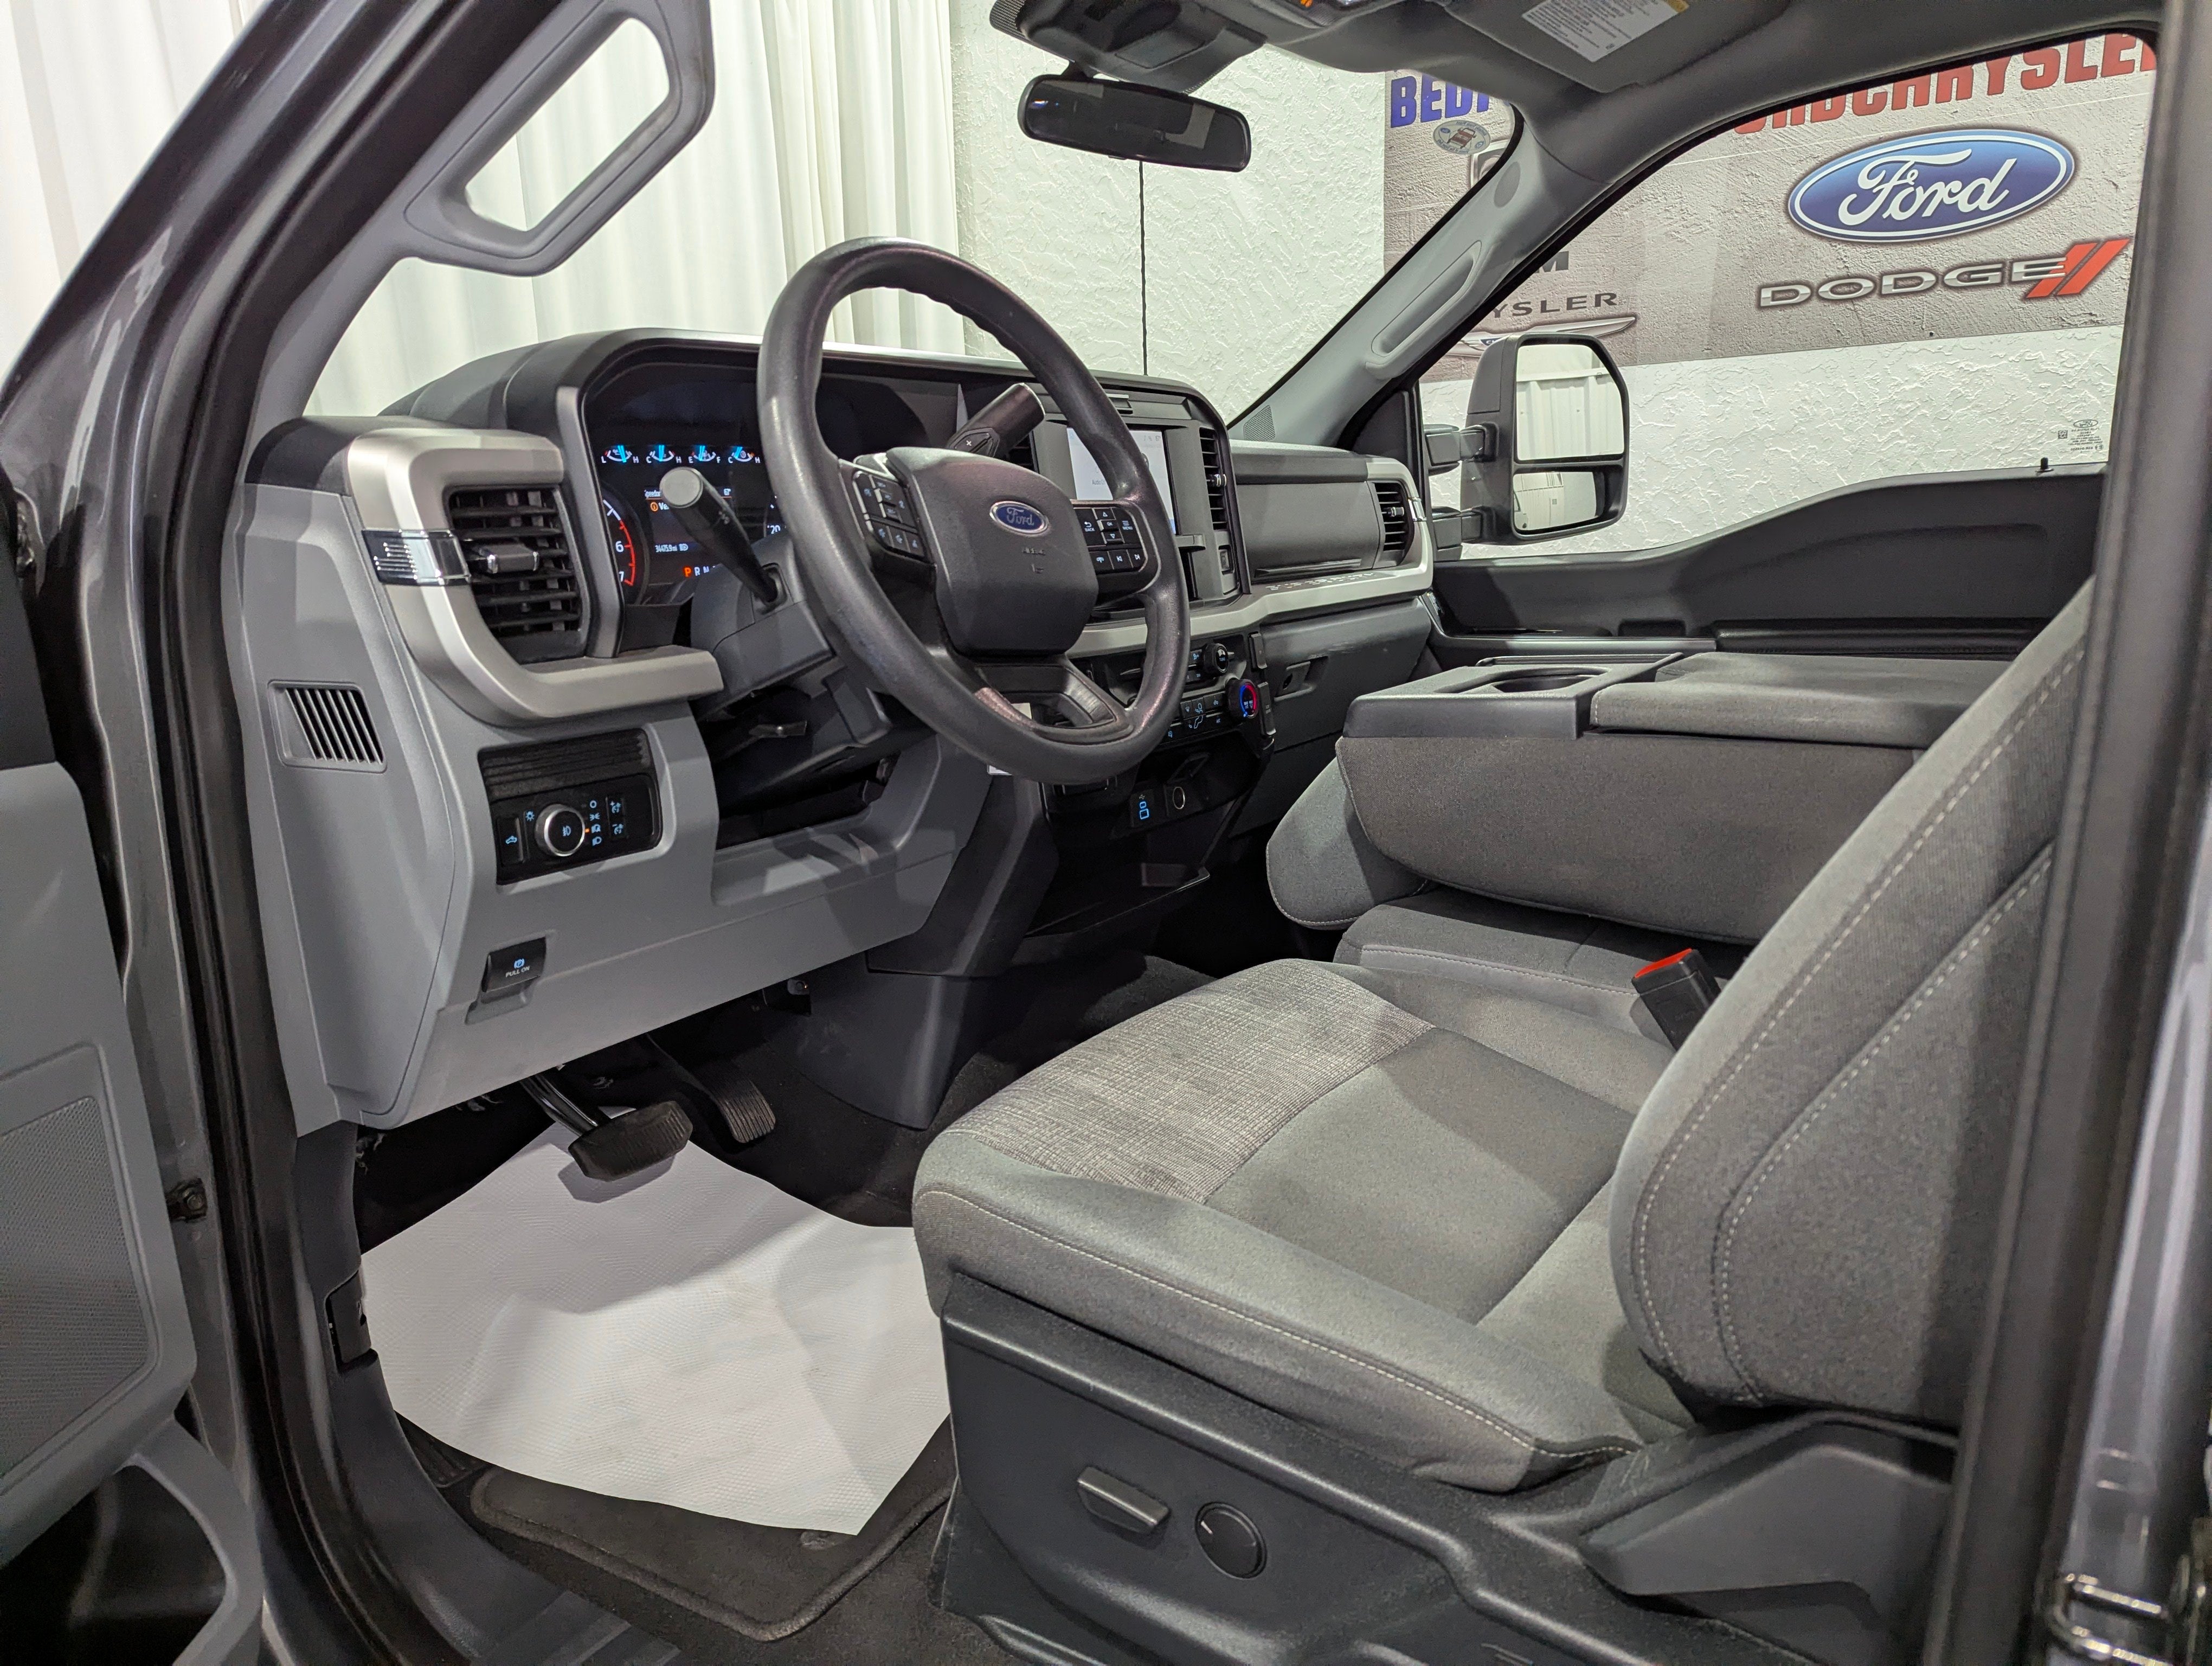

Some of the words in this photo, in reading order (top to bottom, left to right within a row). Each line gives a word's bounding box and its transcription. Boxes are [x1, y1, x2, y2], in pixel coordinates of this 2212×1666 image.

[1838, 149, 2017, 226] Ford
[1760, 257, 2067, 307] DODGE
[1006, 507, 1034, 526] Ford
[615, 540, 624, 553] 6
[684, 567, 691, 577] P
[694, 567, 700, 576] R
[505, 970, 520, 978] PULL
